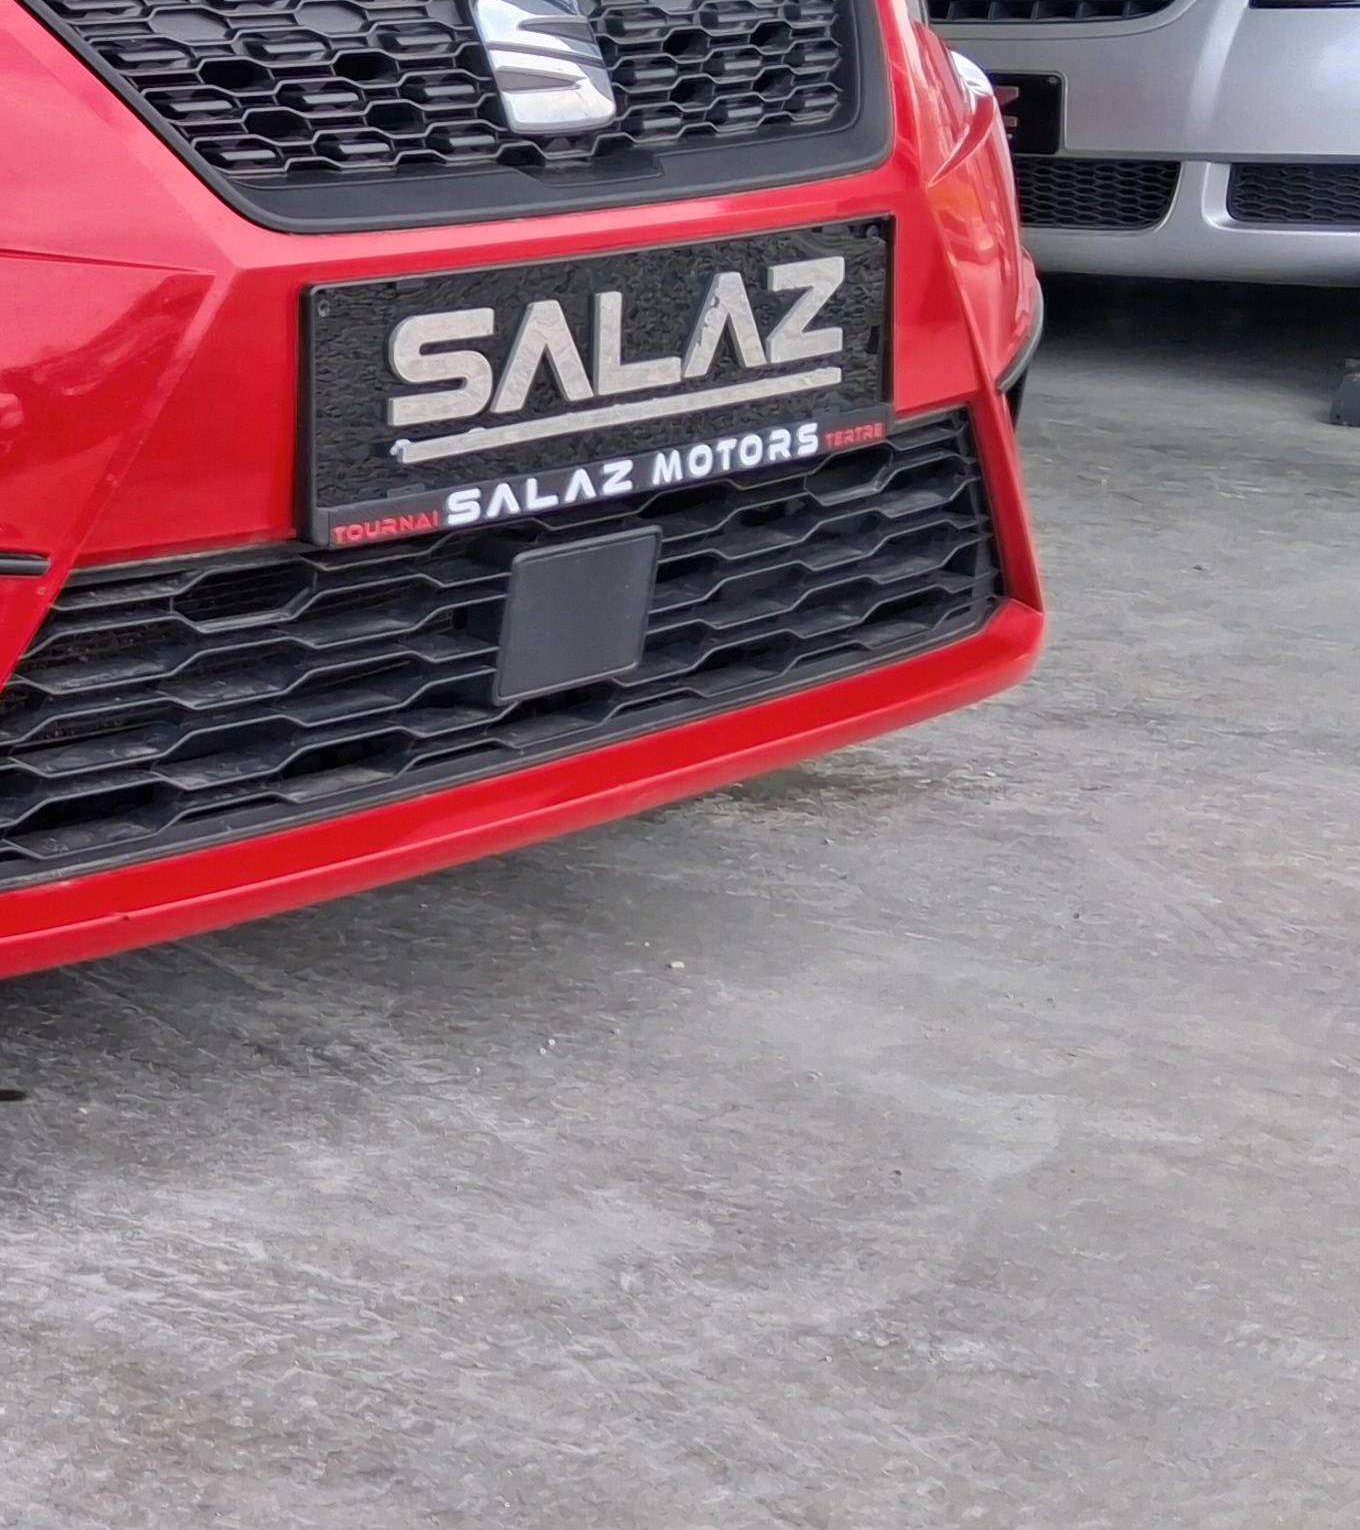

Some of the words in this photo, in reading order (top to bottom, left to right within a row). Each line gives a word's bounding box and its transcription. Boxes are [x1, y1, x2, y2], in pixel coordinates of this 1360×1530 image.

[391, 256, 845, 426] SALAZ
[331, 510, 439, 544] TOURNAI
[445, 458, 634, 526] SALAZ
[650, 421, 819, 485] MOTORS
